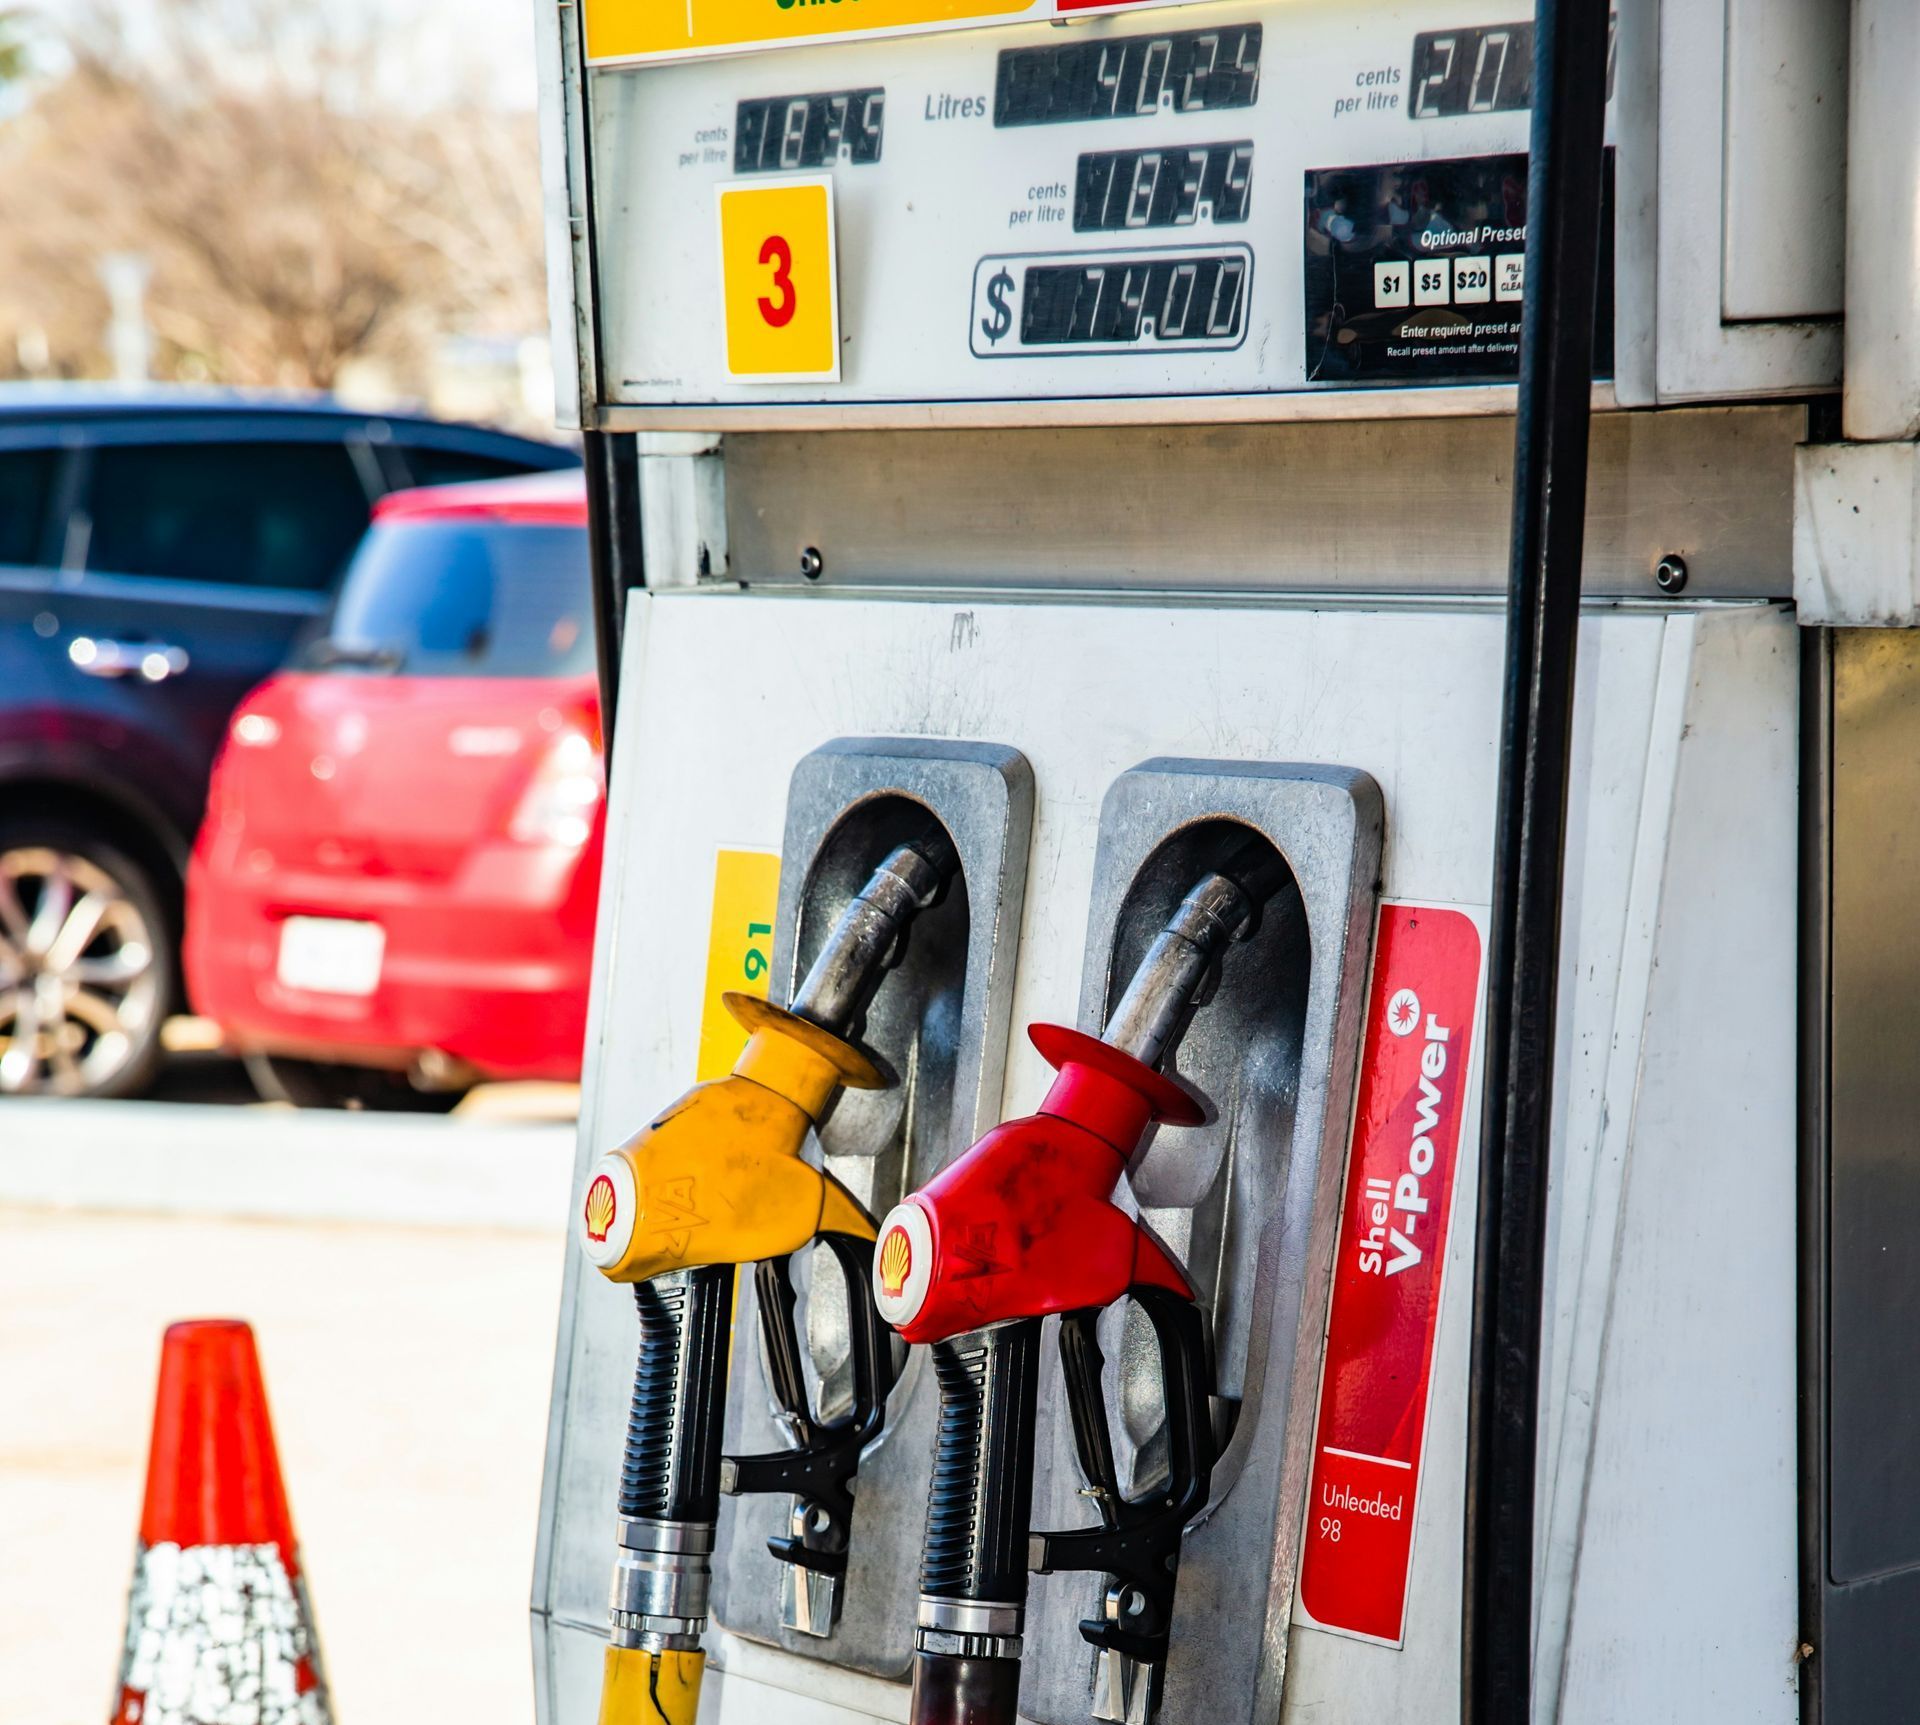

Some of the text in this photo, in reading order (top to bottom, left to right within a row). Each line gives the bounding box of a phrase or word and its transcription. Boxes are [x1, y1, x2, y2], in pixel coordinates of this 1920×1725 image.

[1356, 66, 1400, 87] cents
[924, 94, 986, 121] Litres
[1334, 90, 1399, 117] per litre
[695, 126, 728, 143] cents
[679, 148, 728, 168] per litre
[1028, 183, 1067, 200] cents
[1009, 205, 1065, 229] per litre
[1420, 224, 1527, 250] Optional Preset
[1506, 263, 1522, 273] FILL
[757, 235, 796, 328] 3
[1382, 270, 1488, 295] $1 $5 $20
[1501, 282, 1524, 292] CLEA
[981, 265, 1016, 347] $
[1400, 325, 1429, 339] Enter
[1430, 323, 1473, 339] required
[1474, 321, 1508, 338] preset
[1387, 342, 1519, 358] Recall preset amount after delivery
[744, 922, 772, 981] 91
[1384, 1013, 1450, 1278] V-Power
[1359, 1178, 1392, 1276] Shell
[1323, 1482, 1403, 1520] Unleaded
[1320, 1517, 1341, 1542] 98
